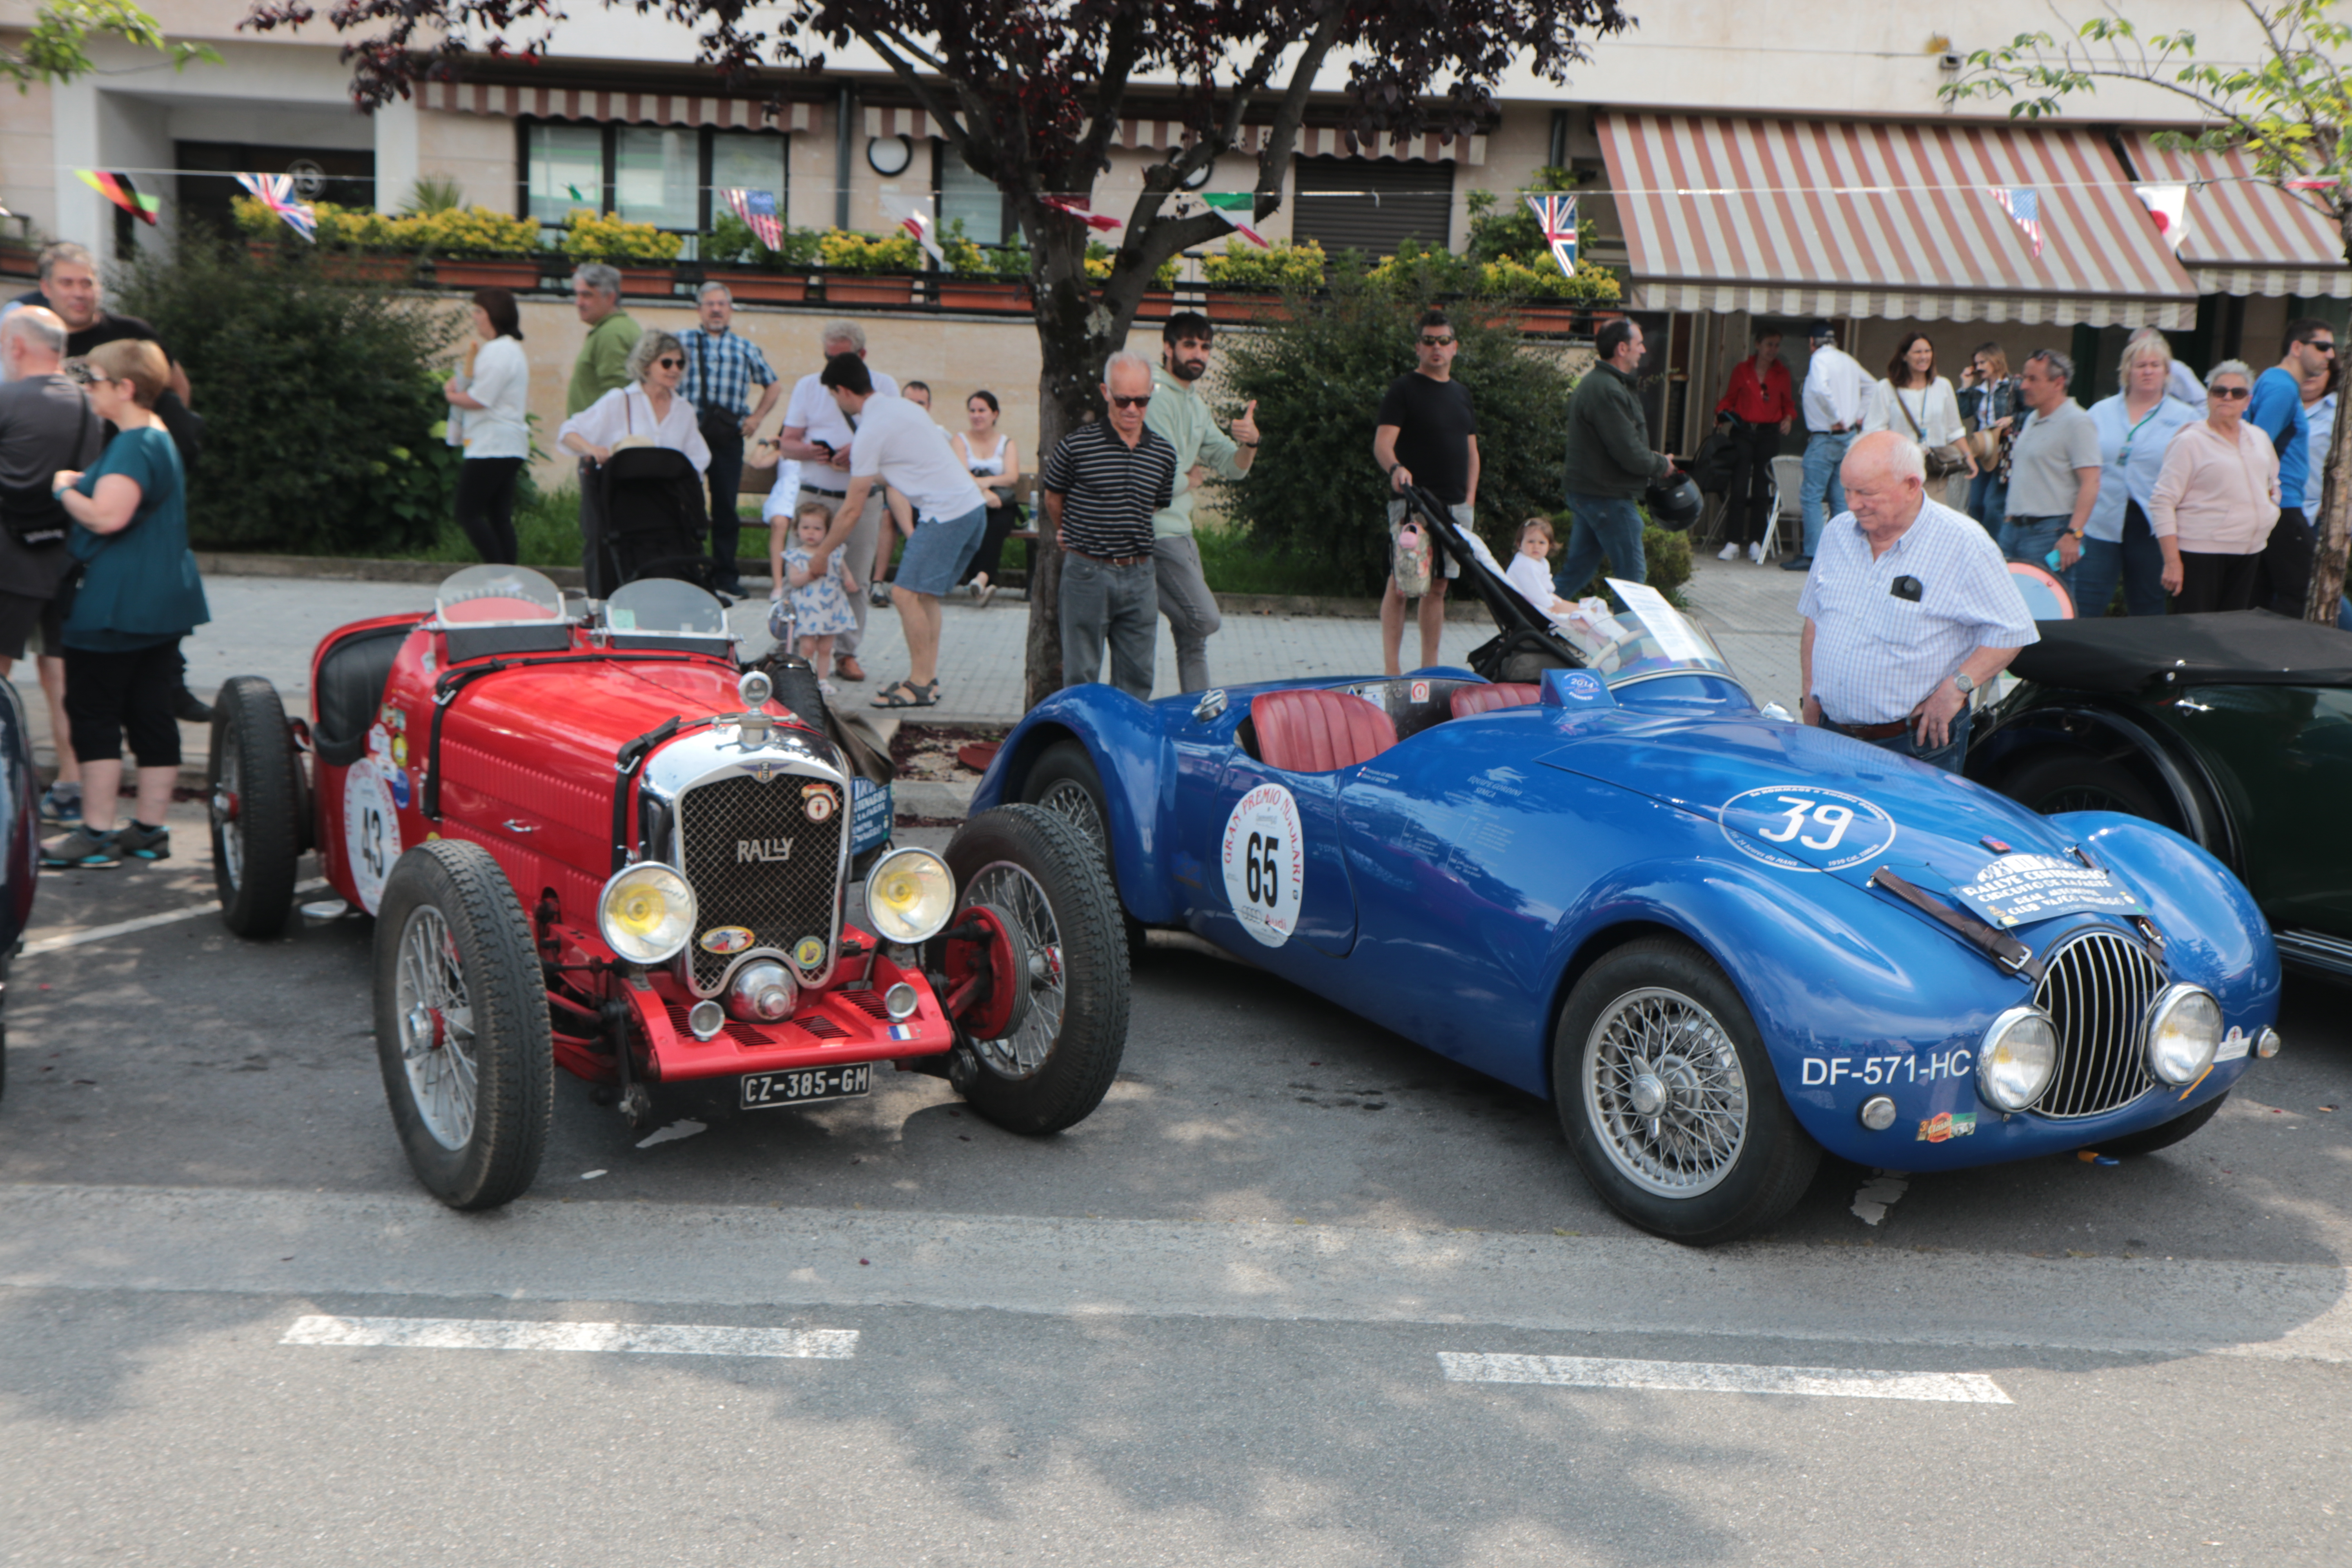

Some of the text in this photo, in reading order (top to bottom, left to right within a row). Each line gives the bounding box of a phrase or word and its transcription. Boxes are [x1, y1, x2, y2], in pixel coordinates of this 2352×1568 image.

[1570, 678, 1594, 688] 2014
[1474, 787, 1497, 798] SIMCA
[1492, 782, 1523, 797] GORDINI
[1758, 795, 1855, 851] 39
[361, 806, 384, 879] 43
[1224, 788, 1301, 883] GRAN PREMIO NUVOLARI
[737, 837, 794, 863] RALLY
[1743, 844, 1766, 857] heures
[1775, 857, 1798, 866] MANS
[1247, 831, 1279, 908] 65
[1962, 869, 2107, 897] RALLYE CENTENARIO
[1977, 881, 2045, 902] CIRCUITO
[2043, 879, 2062, 887] DE
[2007, 903, 2041, 915] CLUB
[2013, 892, 2046, 905] REAL
[1265, 913, 1287, 930] Audi
[1802, 1049, 1972, 1085] DF-571-HC
[746, 1067, 867, 1102] CZ-385-GM
